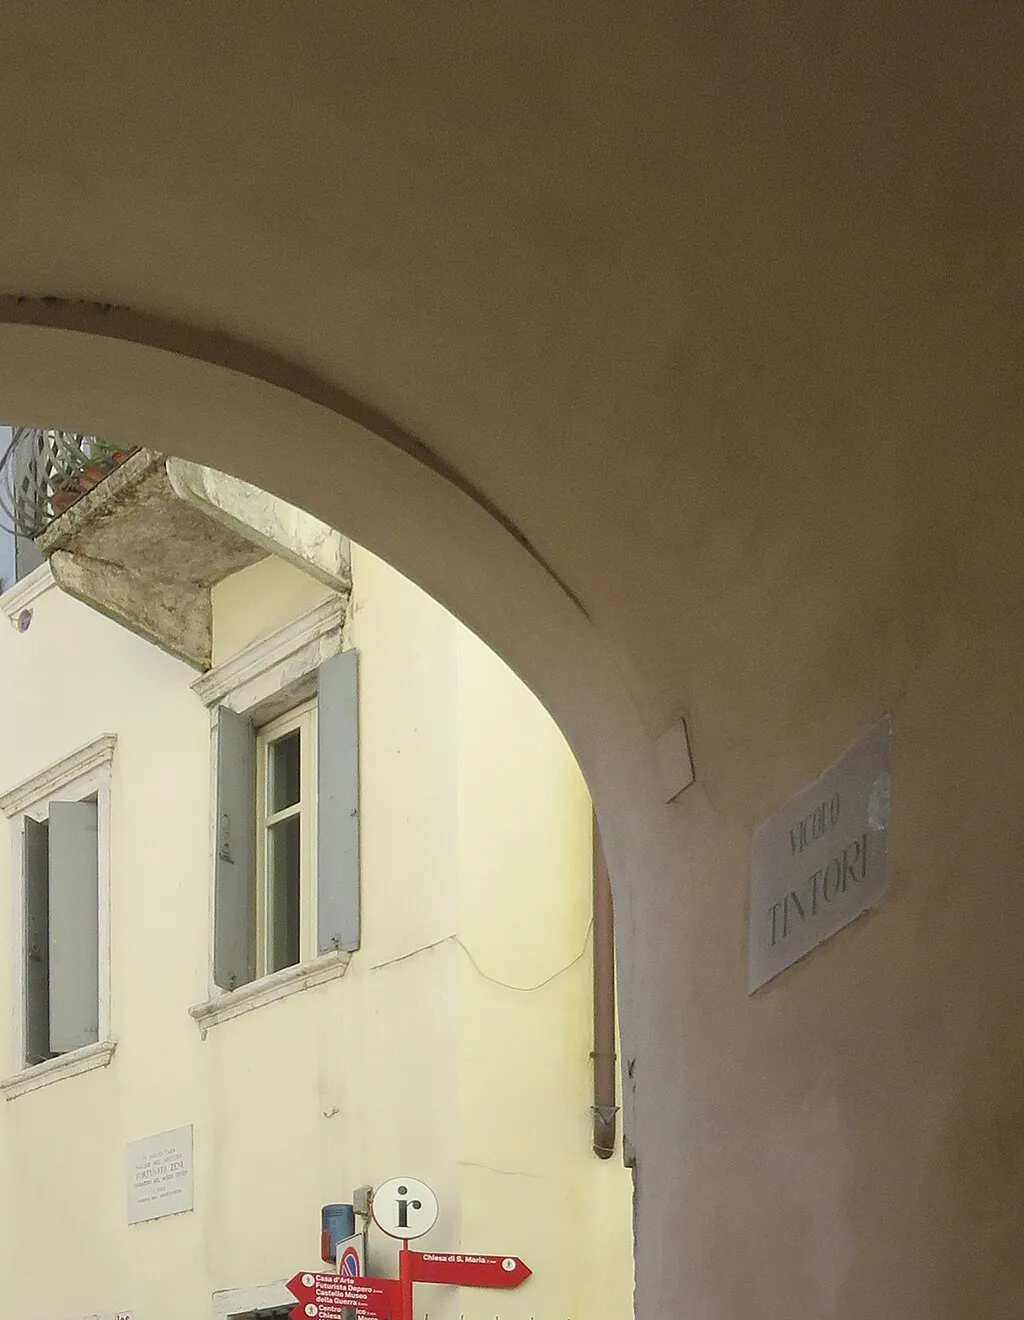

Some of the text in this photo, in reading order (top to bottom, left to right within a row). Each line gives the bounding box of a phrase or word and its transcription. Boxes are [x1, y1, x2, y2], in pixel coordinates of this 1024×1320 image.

[789, 793, 842, 857] VICOLO
[768, 834, 869, 948] TINTORI
[422, 1254, 447, 1262] Chiesa
[456, 1255, 464, 1263] S.
[465, 1256, 486, 1264] Maria
[316, 1274, 355, 1285] Casa d'Arte
[316, 1282, 346, 1291] Futurista
[348, 1284, 372, 1293] Depero
[316, 1289, 344, 1298] Castello
[344, 1291, 368, 1300] Museo
[316, 1296, 333, 1304] della
[334, 1297, 357, 1306] Guerra
[318, 1304, 342, 1313] Centro
[318, 1311, 342, 1320] Chiesa
